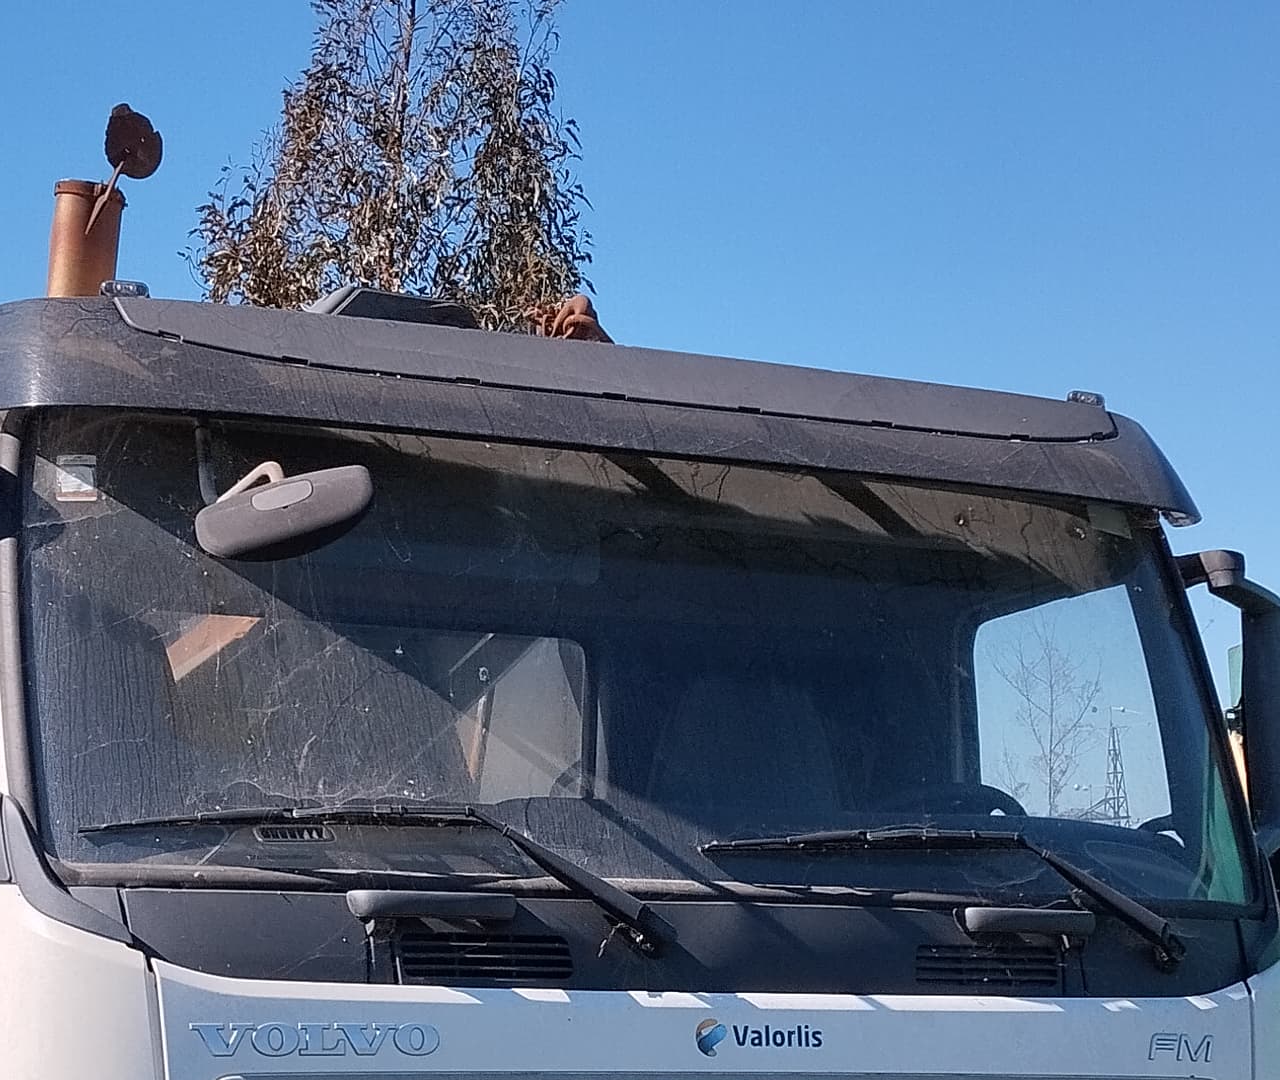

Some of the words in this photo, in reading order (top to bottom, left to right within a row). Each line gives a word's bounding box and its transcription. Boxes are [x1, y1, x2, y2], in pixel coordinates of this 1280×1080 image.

[189, 1022, 440, 1057] VOLVO
[732, 1024, 823, 1048] Valorlis
[1147, 1032, 1214, 1063] FM
